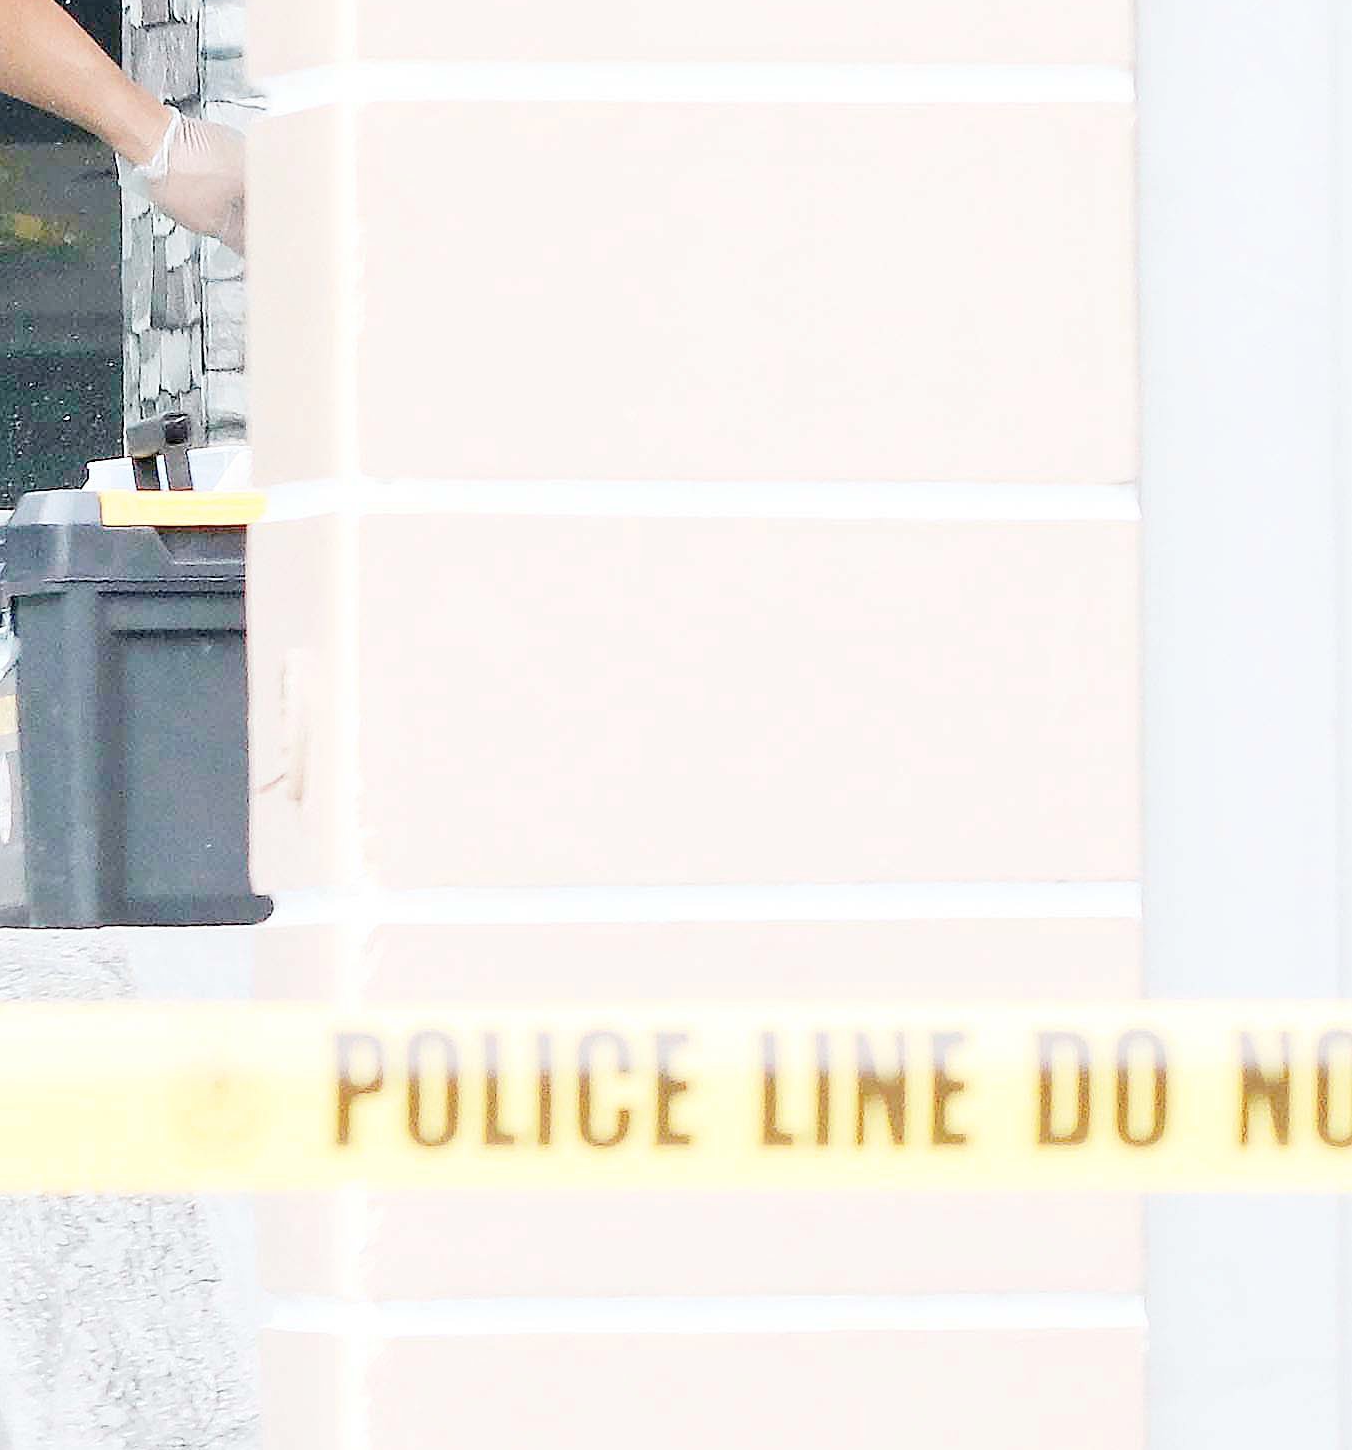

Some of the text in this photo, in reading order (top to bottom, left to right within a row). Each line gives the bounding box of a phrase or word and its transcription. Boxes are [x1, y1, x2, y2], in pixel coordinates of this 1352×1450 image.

[333, 1030, 694, 1150] POLICE
[759, 1030, 970, 1149] LINE
[1034, 1029, 1170, 1149] DO
